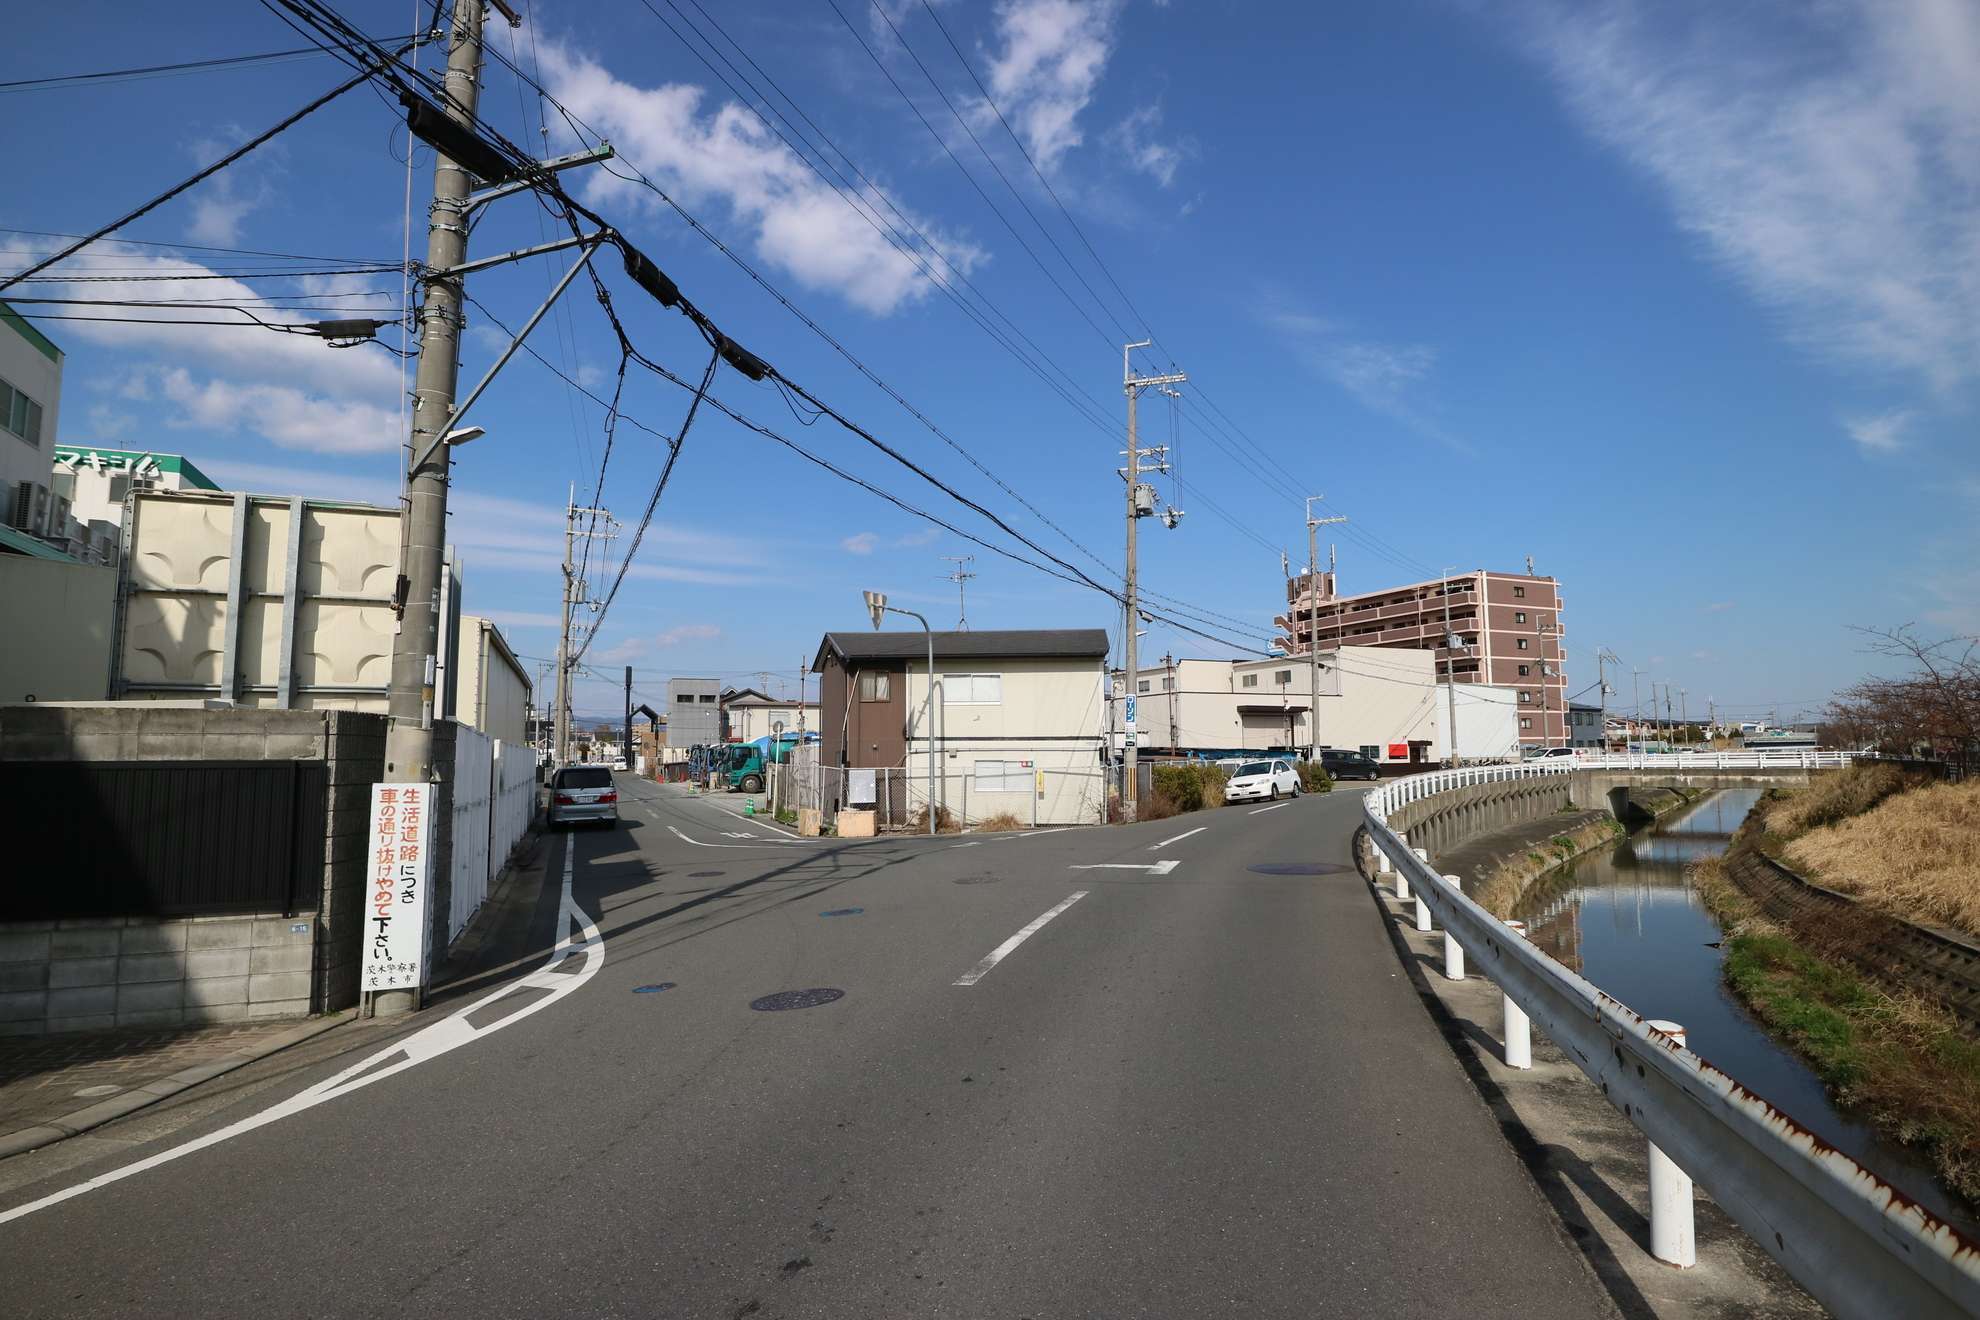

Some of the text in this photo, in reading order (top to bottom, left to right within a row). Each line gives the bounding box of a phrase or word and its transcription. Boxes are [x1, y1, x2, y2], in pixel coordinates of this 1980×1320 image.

[53, 451, 160, 477] マキシム
[373, 788, 398, 962] 車の通り抜けやめて下さい。
[400, 788, 420, 904] 生活道路につき
